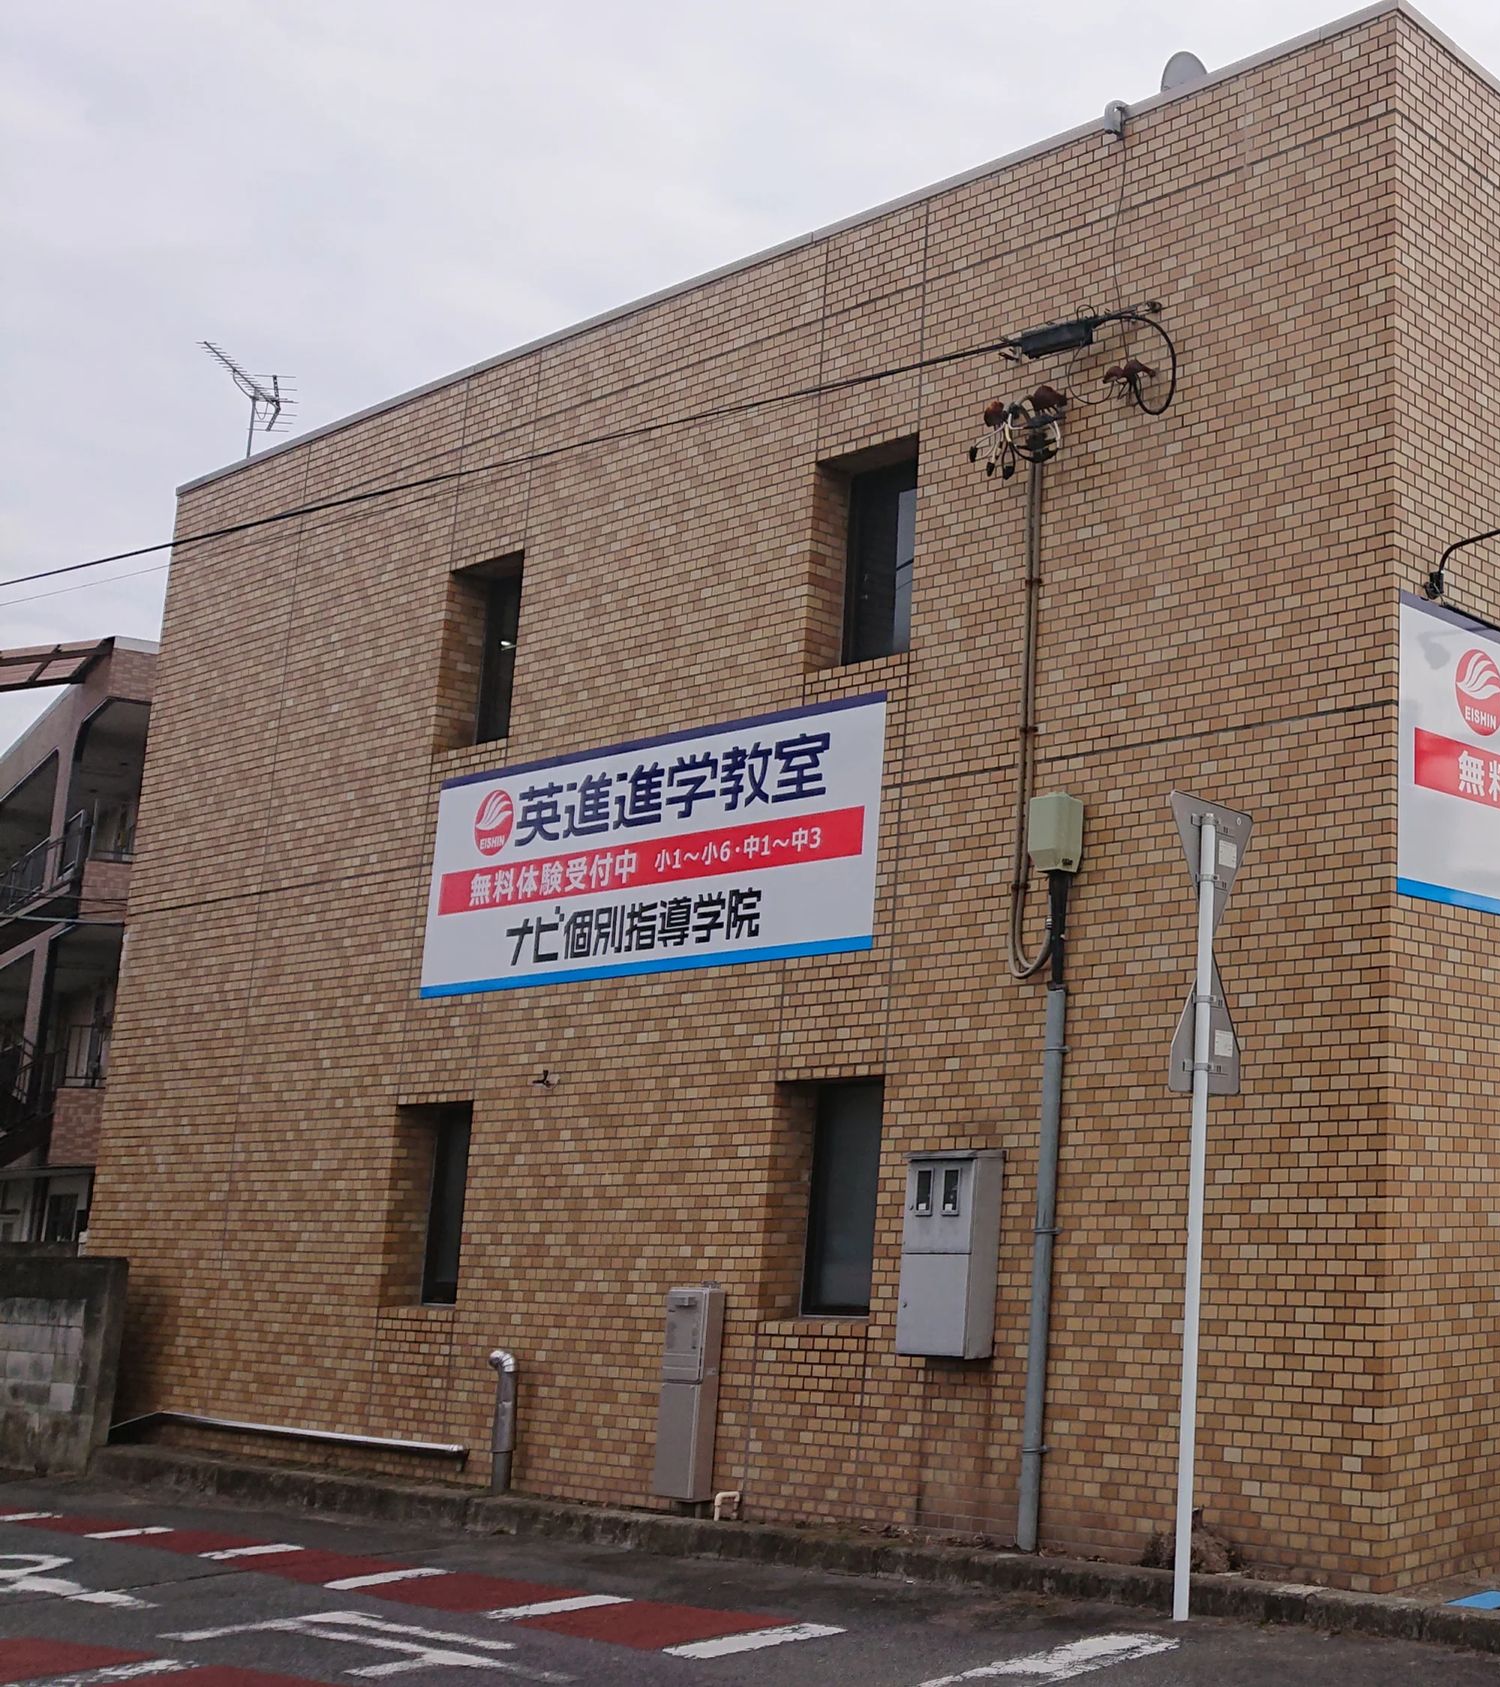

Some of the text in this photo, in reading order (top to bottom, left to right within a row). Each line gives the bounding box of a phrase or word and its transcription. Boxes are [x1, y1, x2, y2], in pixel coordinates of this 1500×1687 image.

[1464, 706, 1498, 730] EISHIN
[514, 731, 830, 847] 英進進学教室
[478, 834, 506, 851] EISHIN
[468, 849, 637, 906] 無料体験受付中
[505, 888, 761, 967] ナビ個別指導学院
